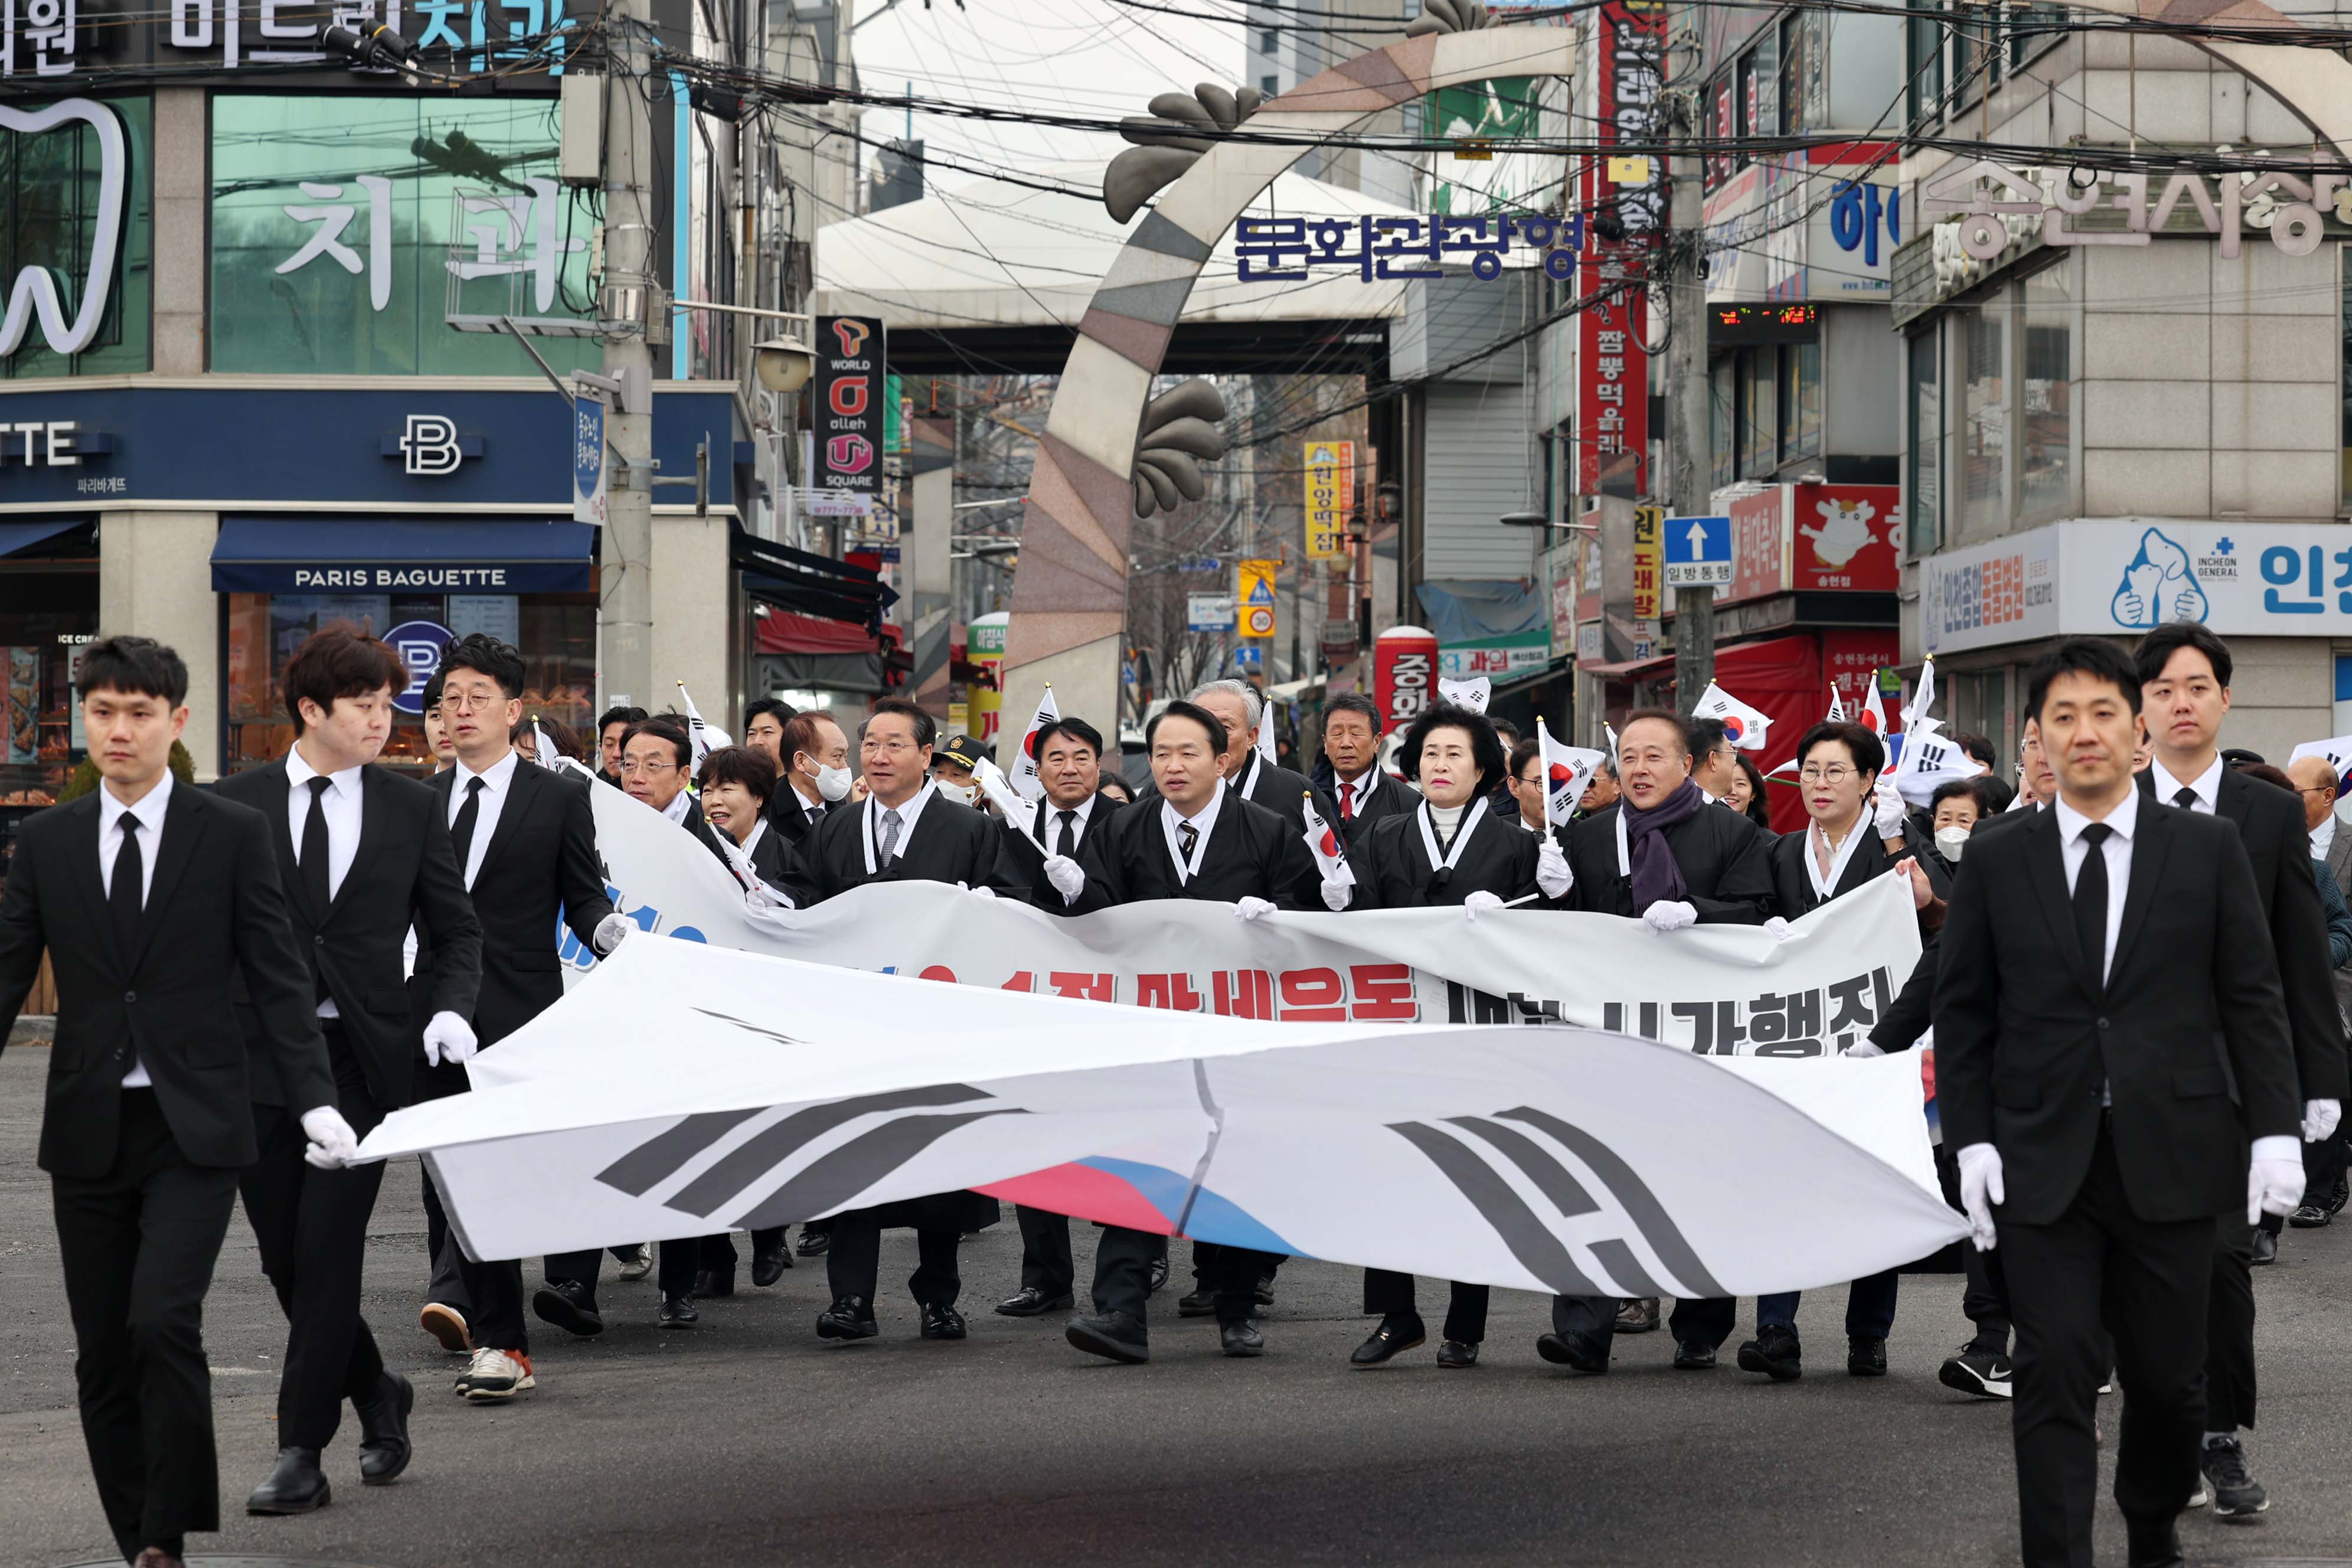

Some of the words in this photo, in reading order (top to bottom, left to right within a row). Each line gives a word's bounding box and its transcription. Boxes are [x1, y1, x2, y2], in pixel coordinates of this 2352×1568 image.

[1925, 151, 2350, 259] 송현시장
[276, 175, 586, 313] 치과
[1235, 214, 1585, 283] 문화관광형
[831, 360, 871, 371] WORLD
[77, 477, 126, 494] 파리바게뜨
[826, 475, 873, 486] SQUARE
[2199, 558, 2236, 566] INCHEON
[295, 569, 368, 586] PARIS
[377, 569, 506, 586] BAGUETTE
[1668, 566, 1730, 582] 일방통행
[2199, 568, 2239, 577] GENERAL
[1255, 616, 1268, 626] 30
[58, 635, 73, 644] ICE
[1468, 650, 1508, 671] 과일
[1833, 653, 1889, 665] 송현동에서
